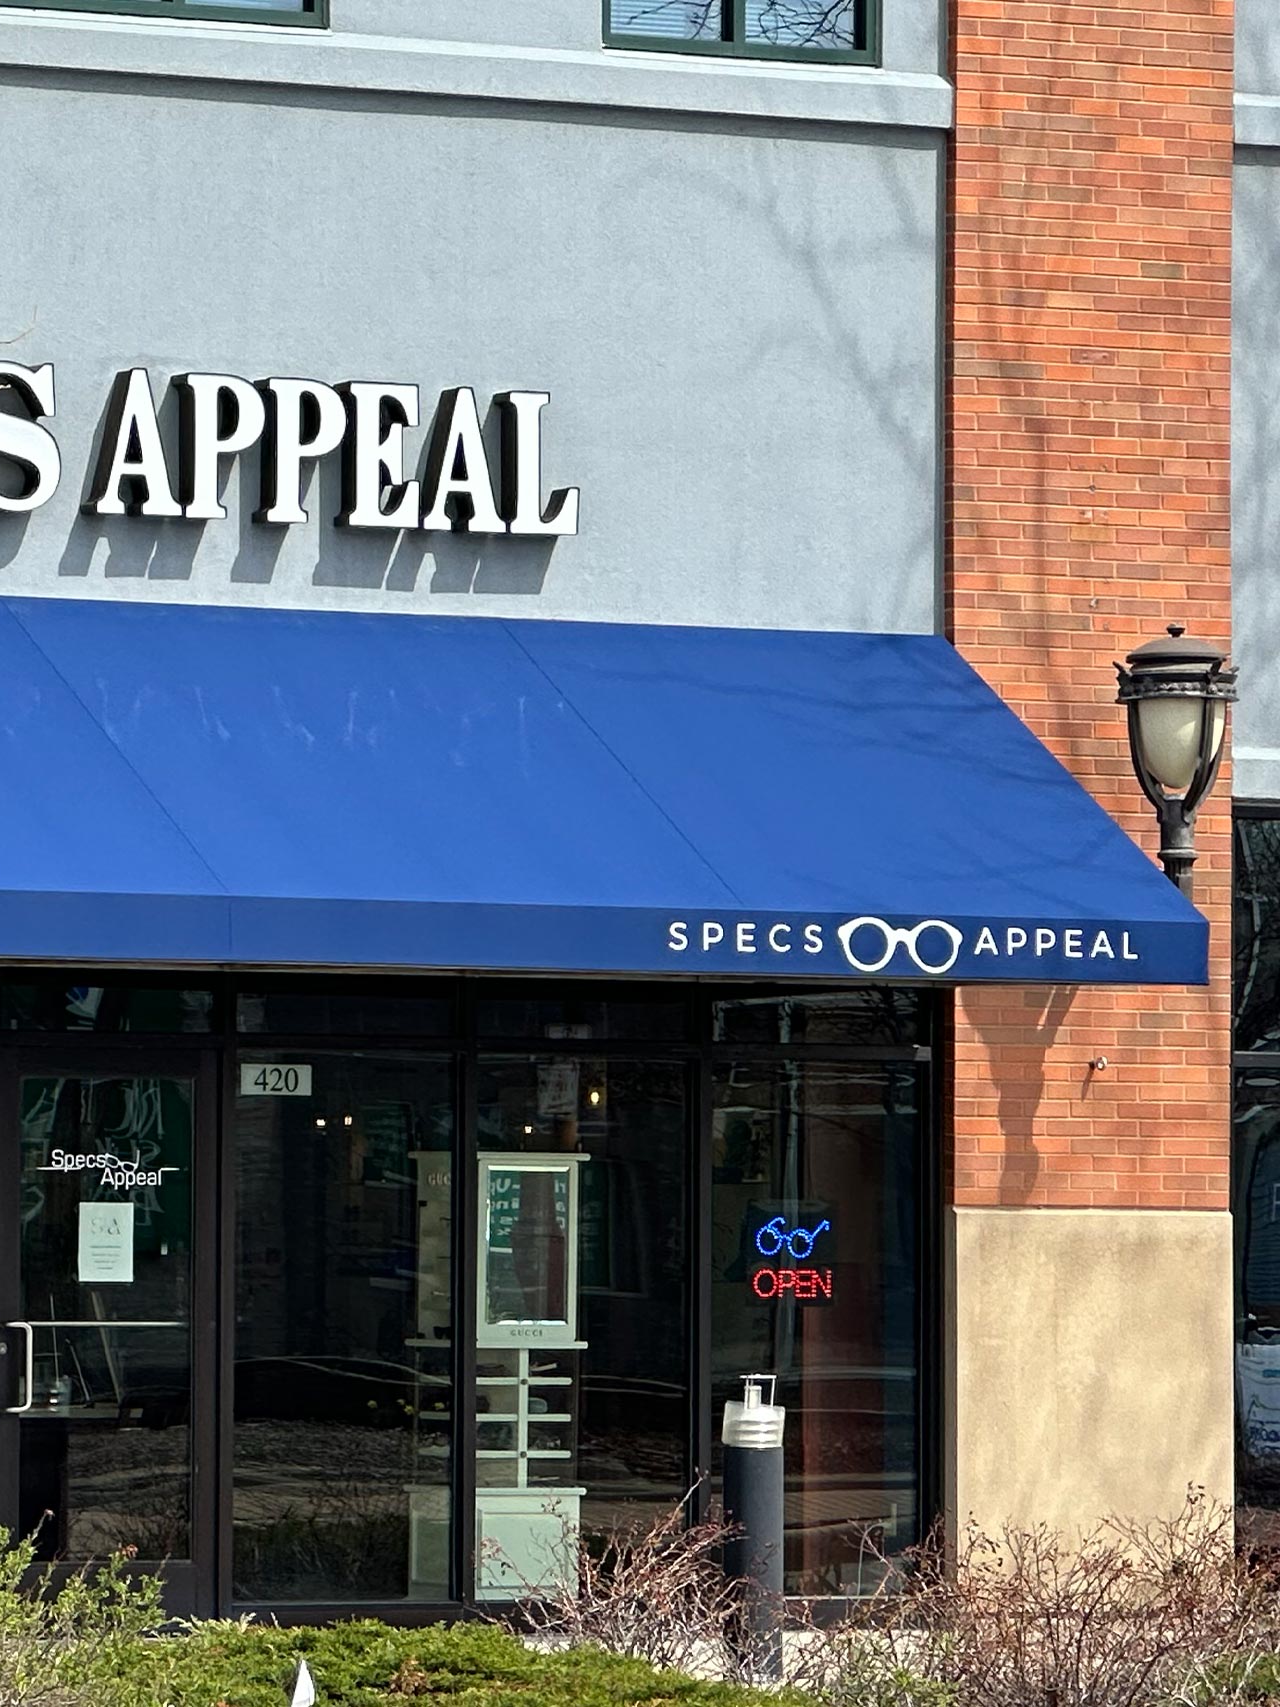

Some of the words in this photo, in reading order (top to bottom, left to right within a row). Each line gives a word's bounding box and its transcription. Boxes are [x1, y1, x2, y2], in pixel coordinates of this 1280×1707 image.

[82, 366, 580, 537] APPEAL
[668, 922, 823, 953] SPECS
[973, 926, 1139, 960] APPEAL
[253, 1067, 299, 1093] 420
[51, 1148, 107, 1172] Specs
[100, 1166, 162, 1191] Appeal
[752, 1268, 833, 1299] OPEN
[509, 1328, 543, 1338] GUCCI
